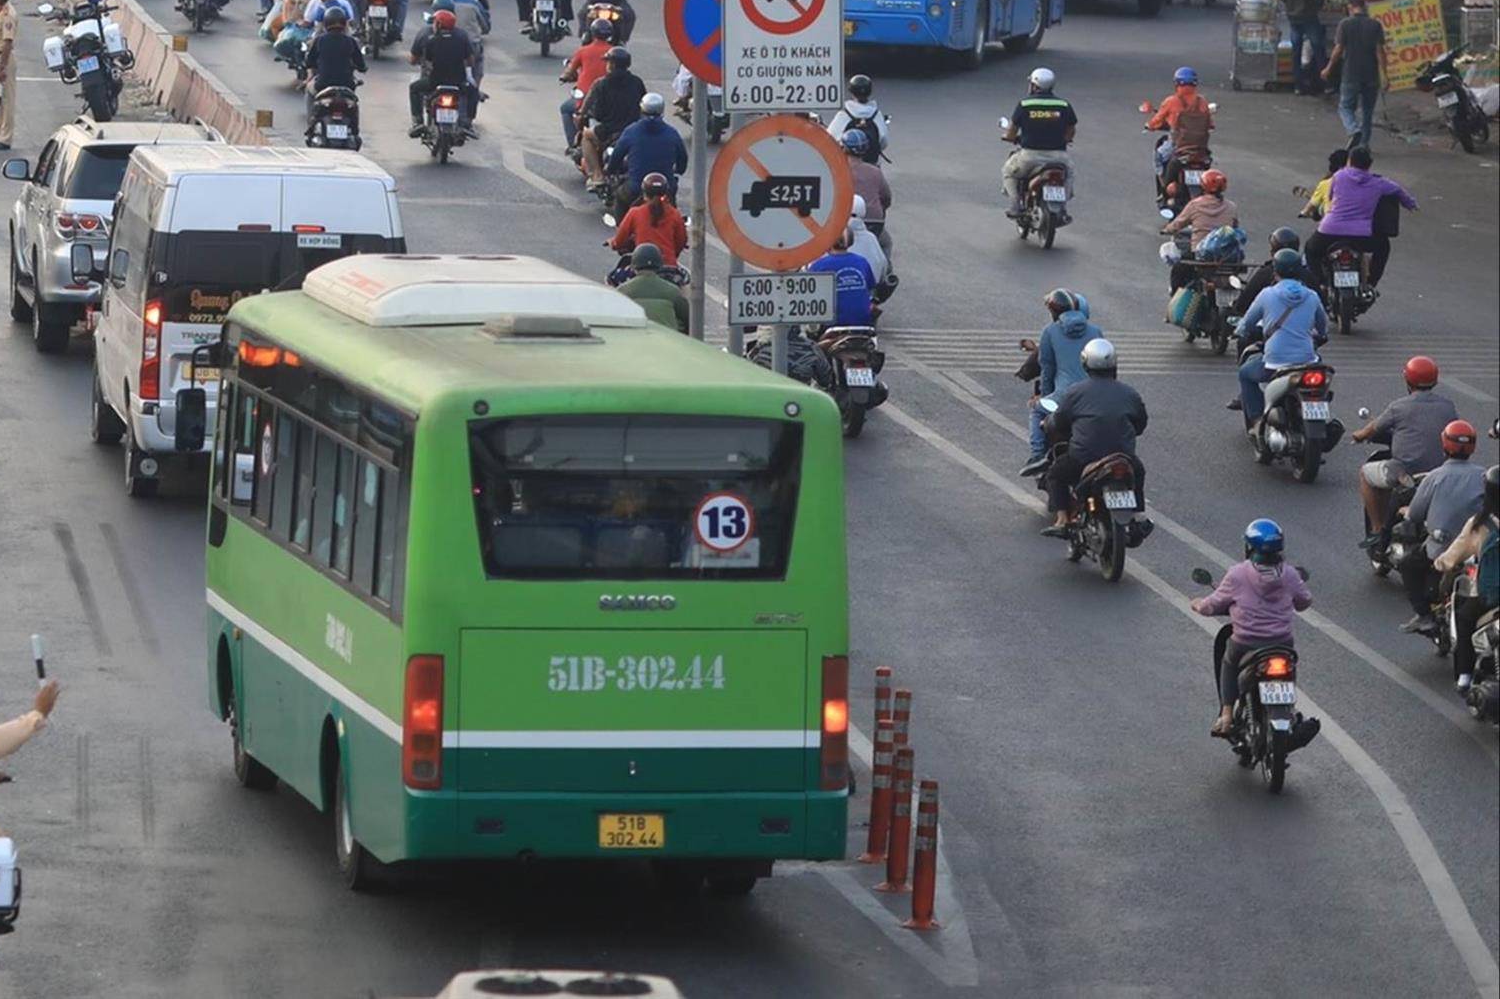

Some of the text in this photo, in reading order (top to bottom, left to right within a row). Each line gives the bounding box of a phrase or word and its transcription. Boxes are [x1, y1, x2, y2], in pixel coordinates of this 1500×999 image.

[742, 43, 831, 59] XE Ô TÔ KHÁCH
[743, 278, 772, 296] 6:00
[786, 277, 817, 296] 9:00
[738, 301, 775, 317] 16:00
[788, 299, 828, 317] 20:00
[701, 505, 746, 539] 13
[548, 654, 726, 693] 51B-302.44
[617, 816, 646, 831] 51B
